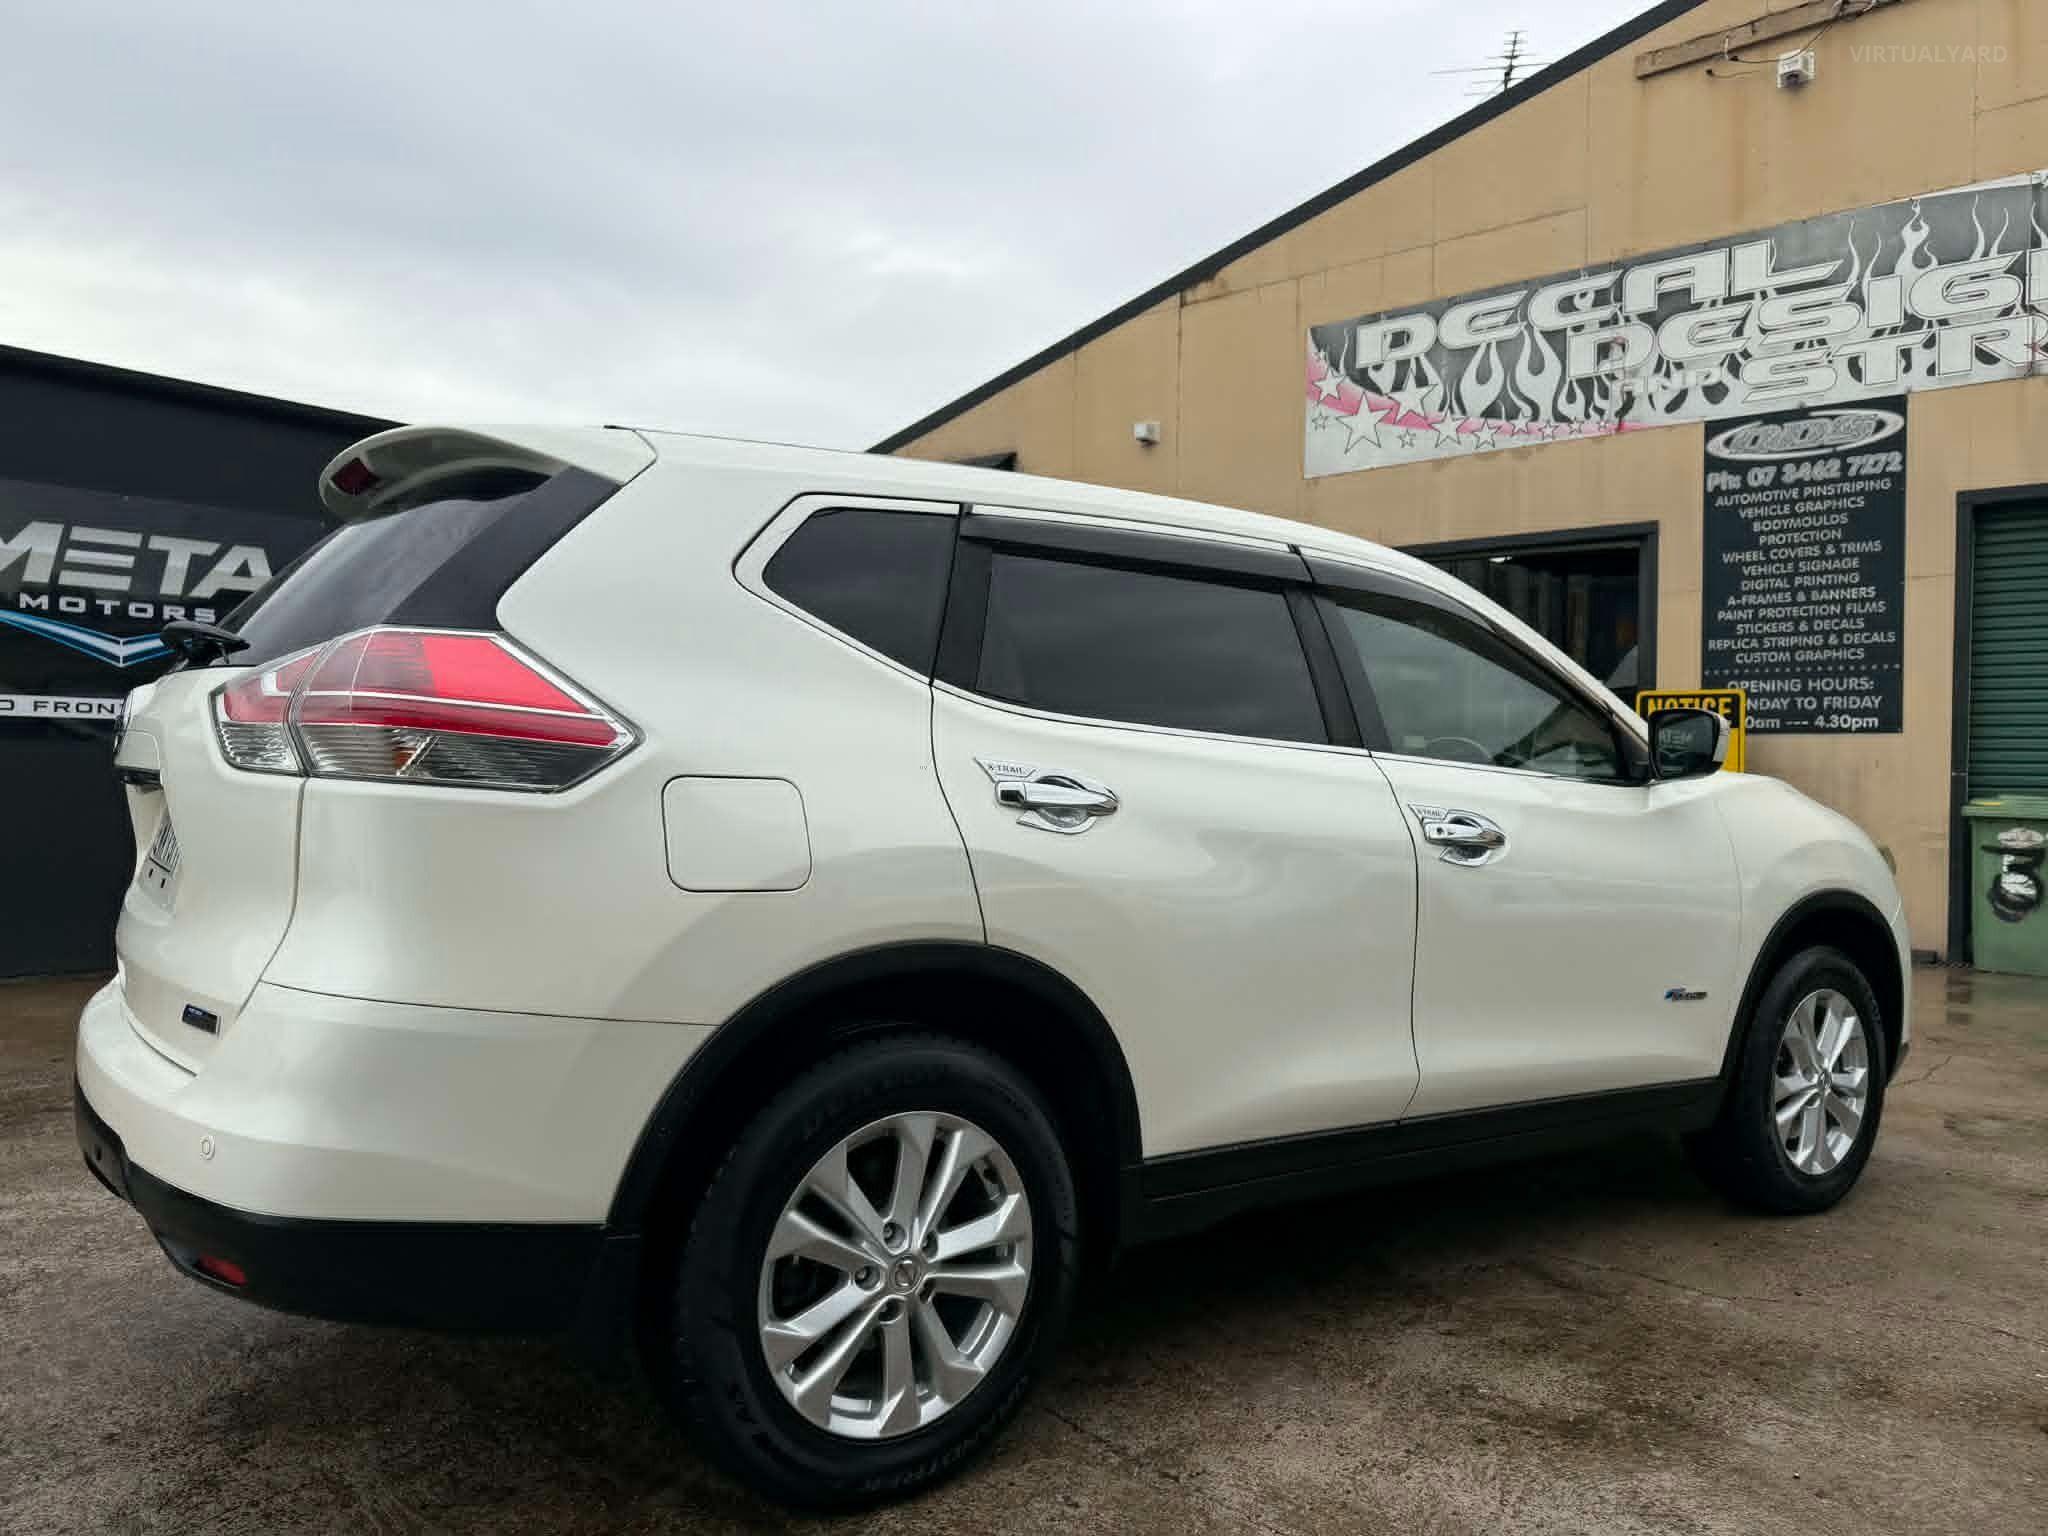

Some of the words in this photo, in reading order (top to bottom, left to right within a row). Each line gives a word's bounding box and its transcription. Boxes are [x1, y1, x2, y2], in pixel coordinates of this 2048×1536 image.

[1356, 239, 1843, 369] DECAL
[1747, 466, 1777, 487] 07
[1714, 488, 1800, 507] AUTOMOTIVE
[1803, 478, 1892, 499] PINSTRIPING
[1739, 504, 1791, 519] VEHICLE
[1795, 496, 1865, 513] GRAPHICS
[1752, 513, 1848, 532] BODYMOULDS
[1759, 528, 1842, 546] PROTECTION
[0, 521, 273, 600] META
[1722, 550, 1767, 564] WHEEL
[1770, 546, 1821, 560] COVERS
[1825, 543, 1836, 554] &
[1839, 540, 1882, 553] TRIMS
[1742, 561, 1794, 576] VEHICLE
[1799, 556, 1860, 572] SIGNAGE
[1741, 578, 1790, 592] DIGITAL
[1794, 573, 1860, 589] PRINTING
[1727, 592, 1792, 606] A-FRAMES
[1797, 591, 1807, 602] &
[1811, 586, 1877, 602] BANNERS
[19, 592, 217, 624] MOTORS
[1717, 609, 1754, 622] PAINT
[1758, 603, 1841, 620] PROTECTION
[1845, 601, 1887, 614] FILMS
[1736, 621, 1794, 635] STICKERS
[1799, 620, 1809, 632] &
[1813, 617, 1865, 631] DECALS
[1708, 637, 1759, 651] REPLICA
[1763, 634, 1824, 649] STRIPING
[1828, 633, 1839, 645] &
[1843, 630, 1896, 645] DECALS
[1735, 651, 1791, 665] CUSTOM
[1795, 647, 1865, 663] GRAPHICS
[1727, 678, 1801, 693] OPENING
[1808, 676, 1875, 692] HOURS:
[33, 700, 122, 716] FRON
[1747, 697, 1790, 711] NDAY
[1794, 696, 1817, 710] TO
[1824, 695, 1883, 710] FRIDAY
[1745, 715, 1781, 729] 0am
[1813, 714, 1879, 732] 4.30pm
